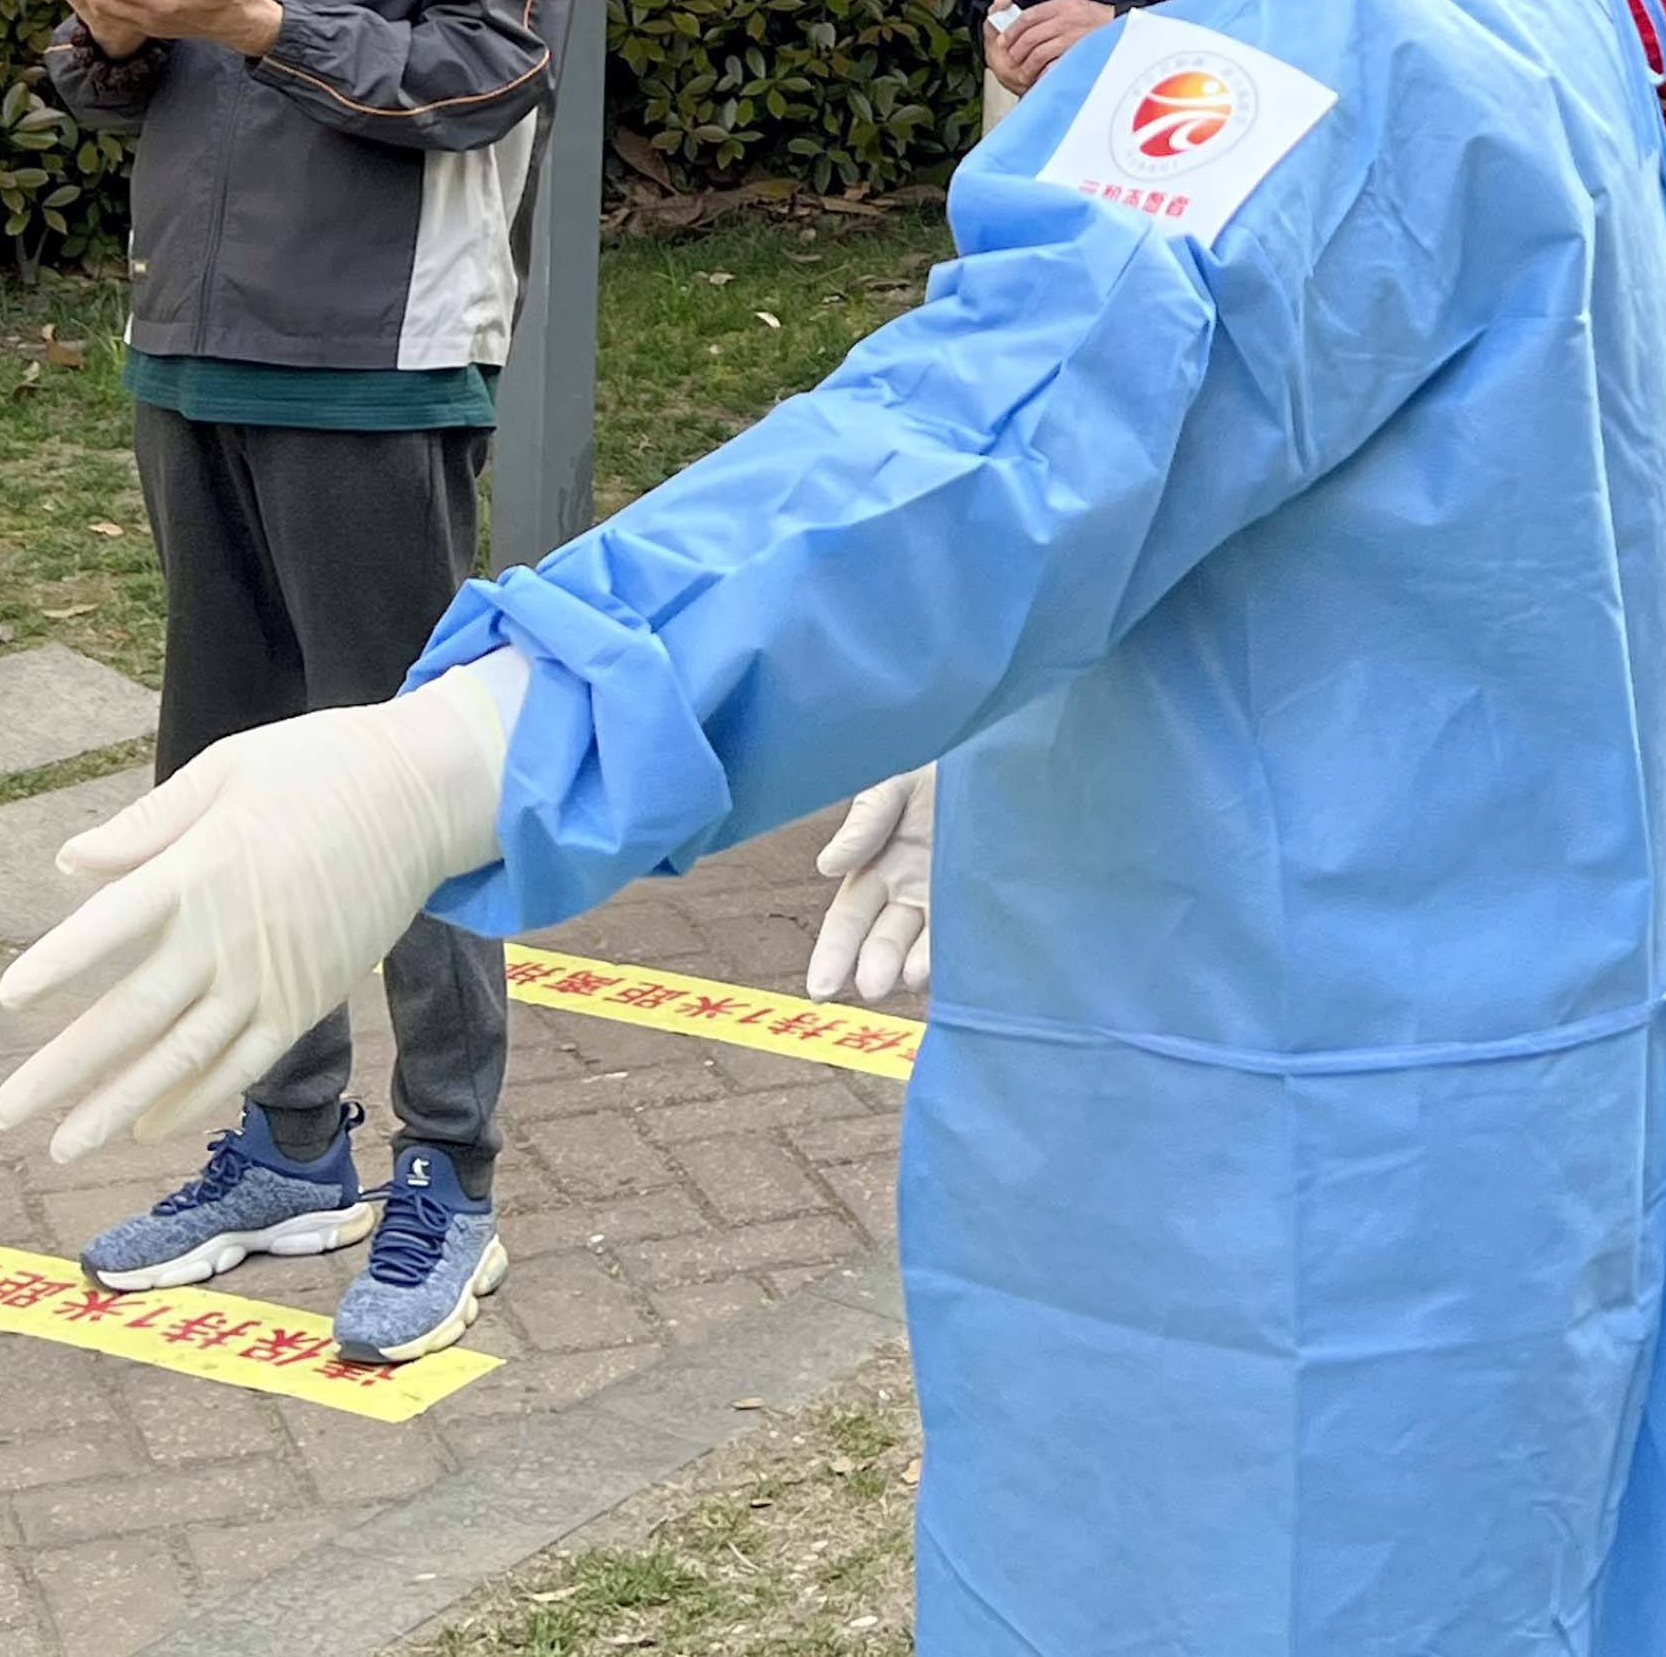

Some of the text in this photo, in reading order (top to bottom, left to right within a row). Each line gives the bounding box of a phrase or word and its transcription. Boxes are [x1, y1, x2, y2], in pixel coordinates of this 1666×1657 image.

[506, 960, 916, 1063] 保持1米距离排
